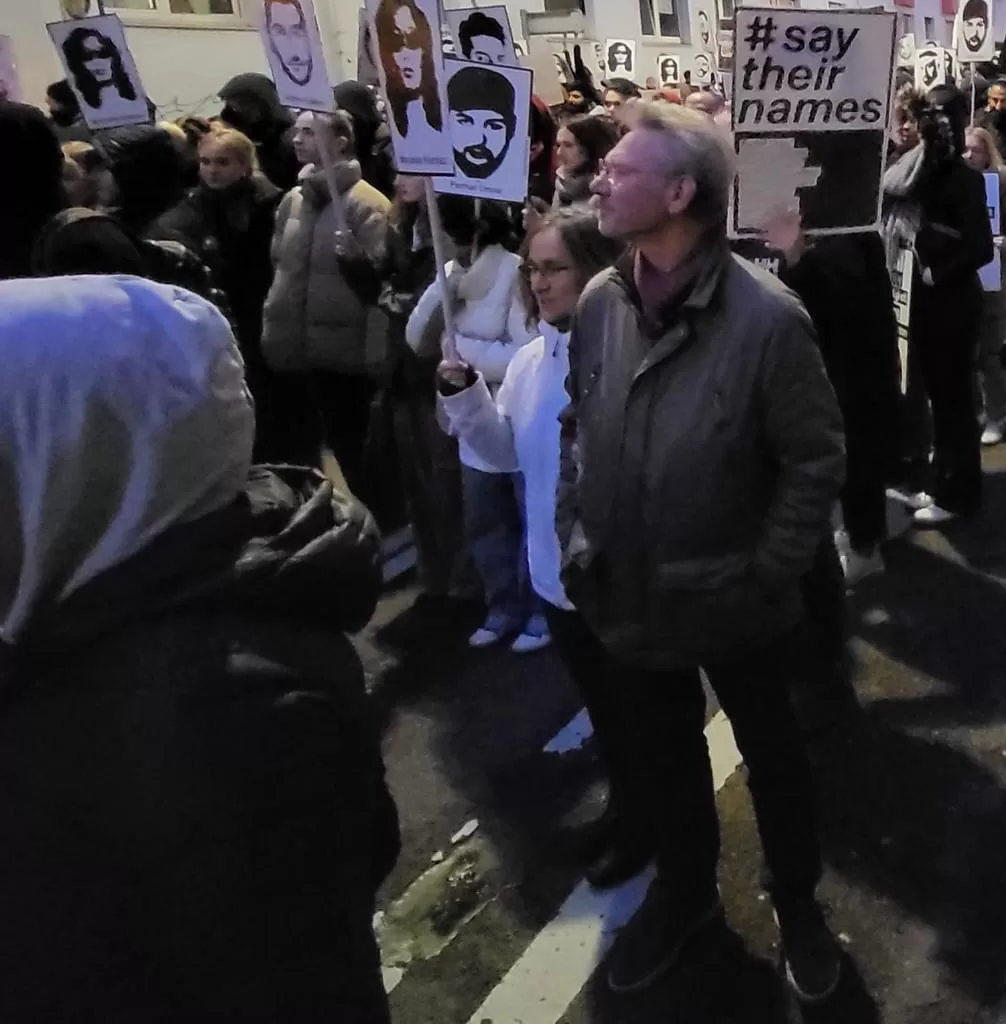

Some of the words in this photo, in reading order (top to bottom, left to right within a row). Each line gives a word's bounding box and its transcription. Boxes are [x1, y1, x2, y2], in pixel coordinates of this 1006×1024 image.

[744, 16, 860, 62] #say
[742, 56, 846, 91] their
[738, 98, 883, 124] names
